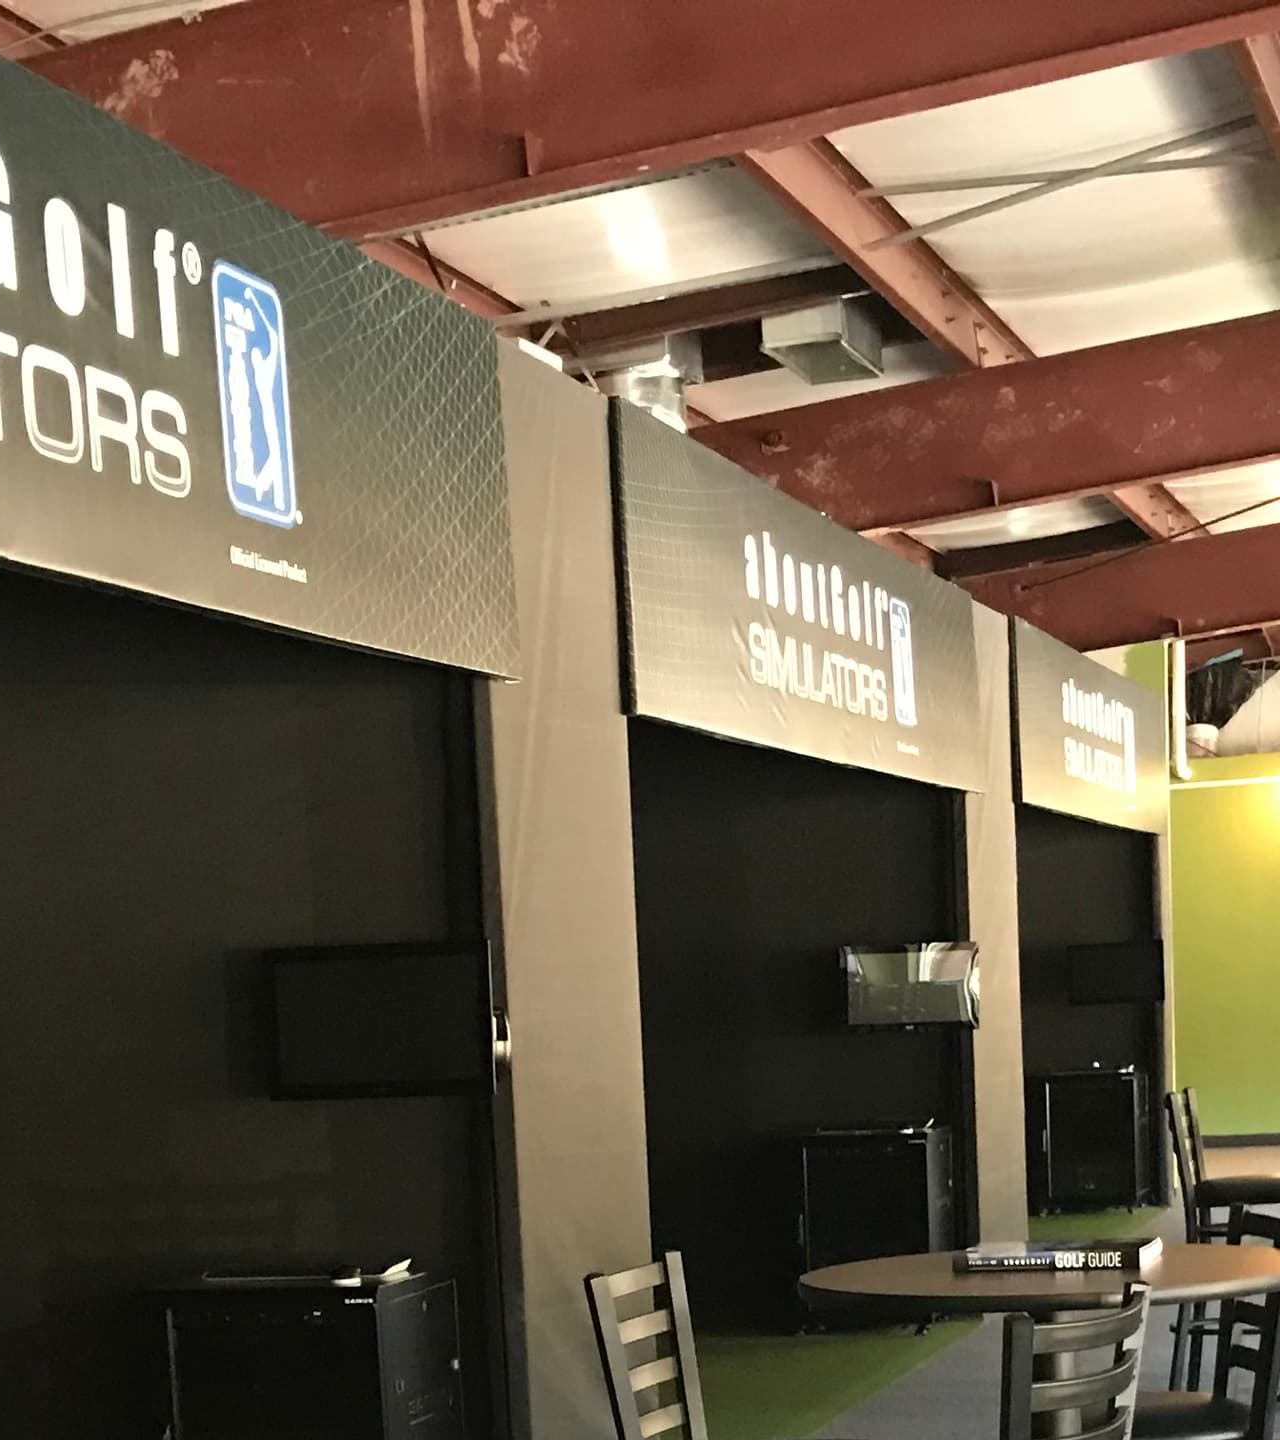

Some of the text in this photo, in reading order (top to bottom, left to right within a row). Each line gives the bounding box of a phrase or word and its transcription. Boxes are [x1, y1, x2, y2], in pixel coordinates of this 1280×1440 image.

[748, 621, 888, 722] SIMULATORS
[1055, 1251, 1086, 1268] GOLF
[1088, 1251, 1122, 1268] GUIDE
